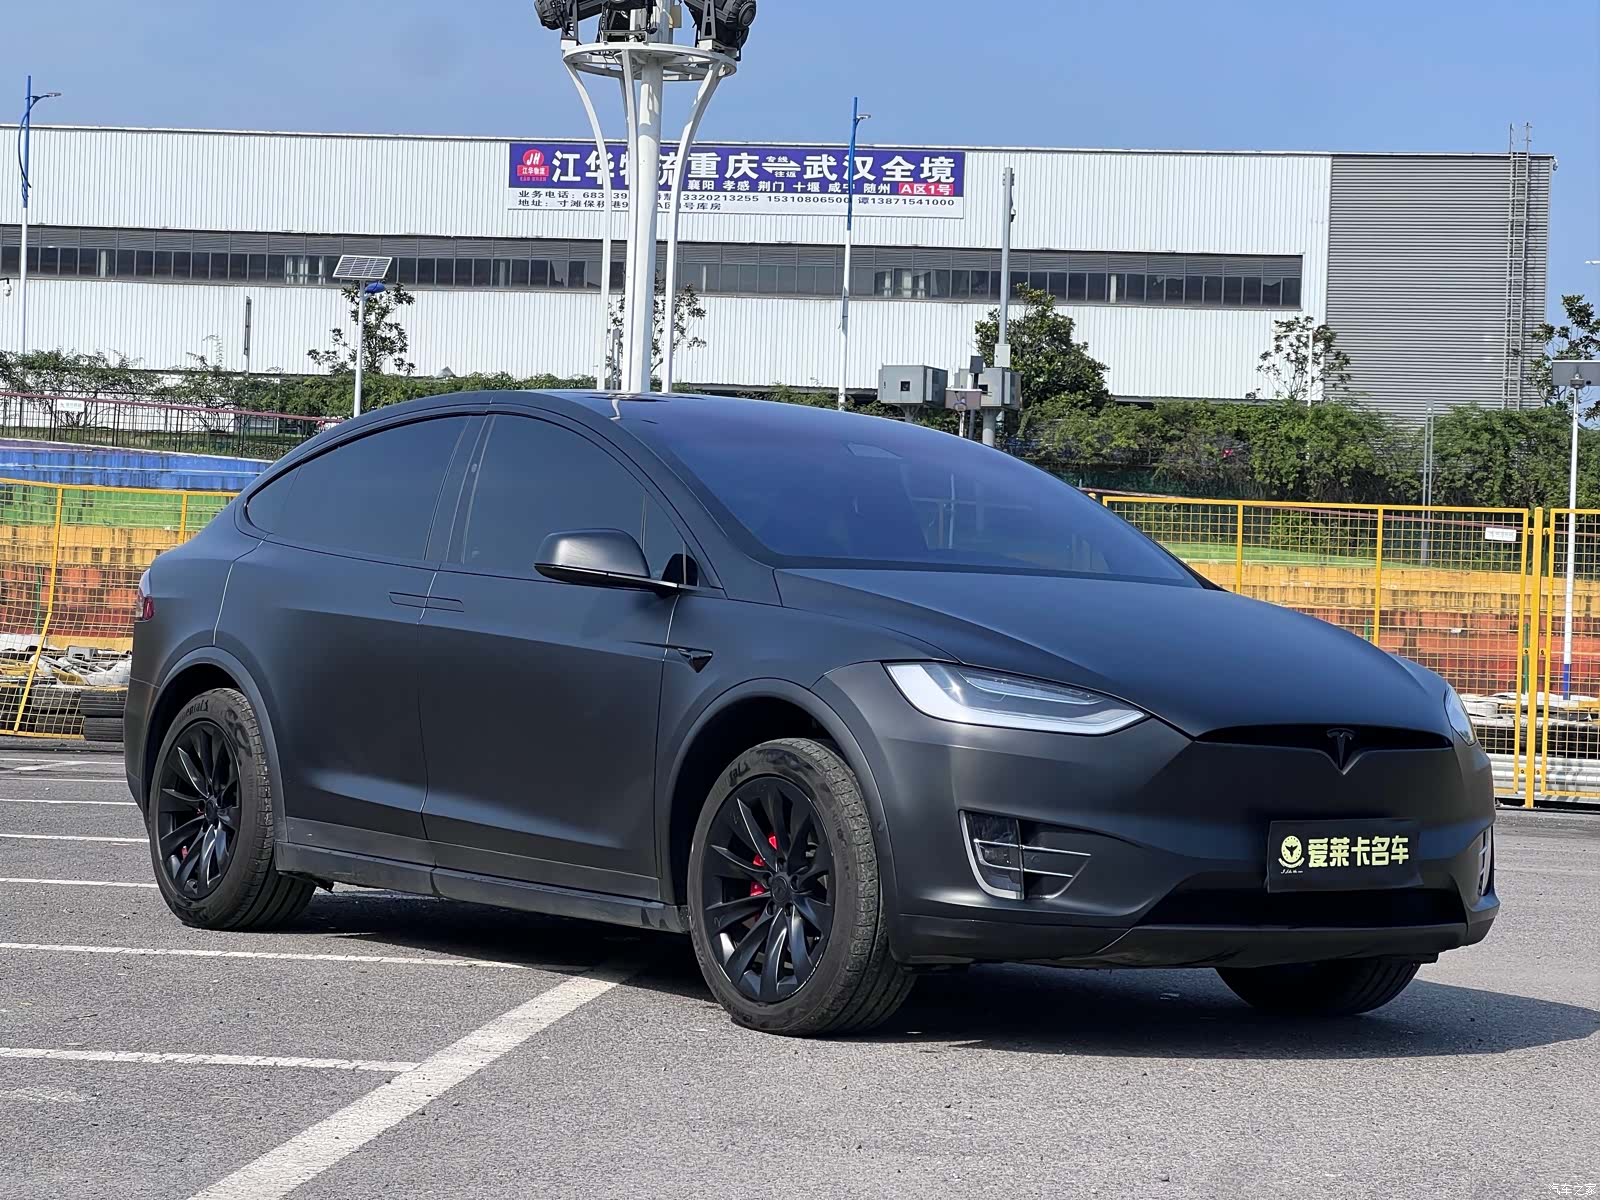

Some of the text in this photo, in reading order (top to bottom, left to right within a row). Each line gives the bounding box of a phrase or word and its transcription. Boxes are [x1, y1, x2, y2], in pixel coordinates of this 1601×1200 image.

[687, 180, 715, 190] 襄阳
[723, 181, 750, 191] 孝感
[757, 181, 785, 192] 荆门
[793, 182, 820, 193] 十堰
[863, 183, 890, 194] 随州
[900, 184, 953, 195] A区1号
[1308, 835, 1409, 867] 爱莱卡名车
